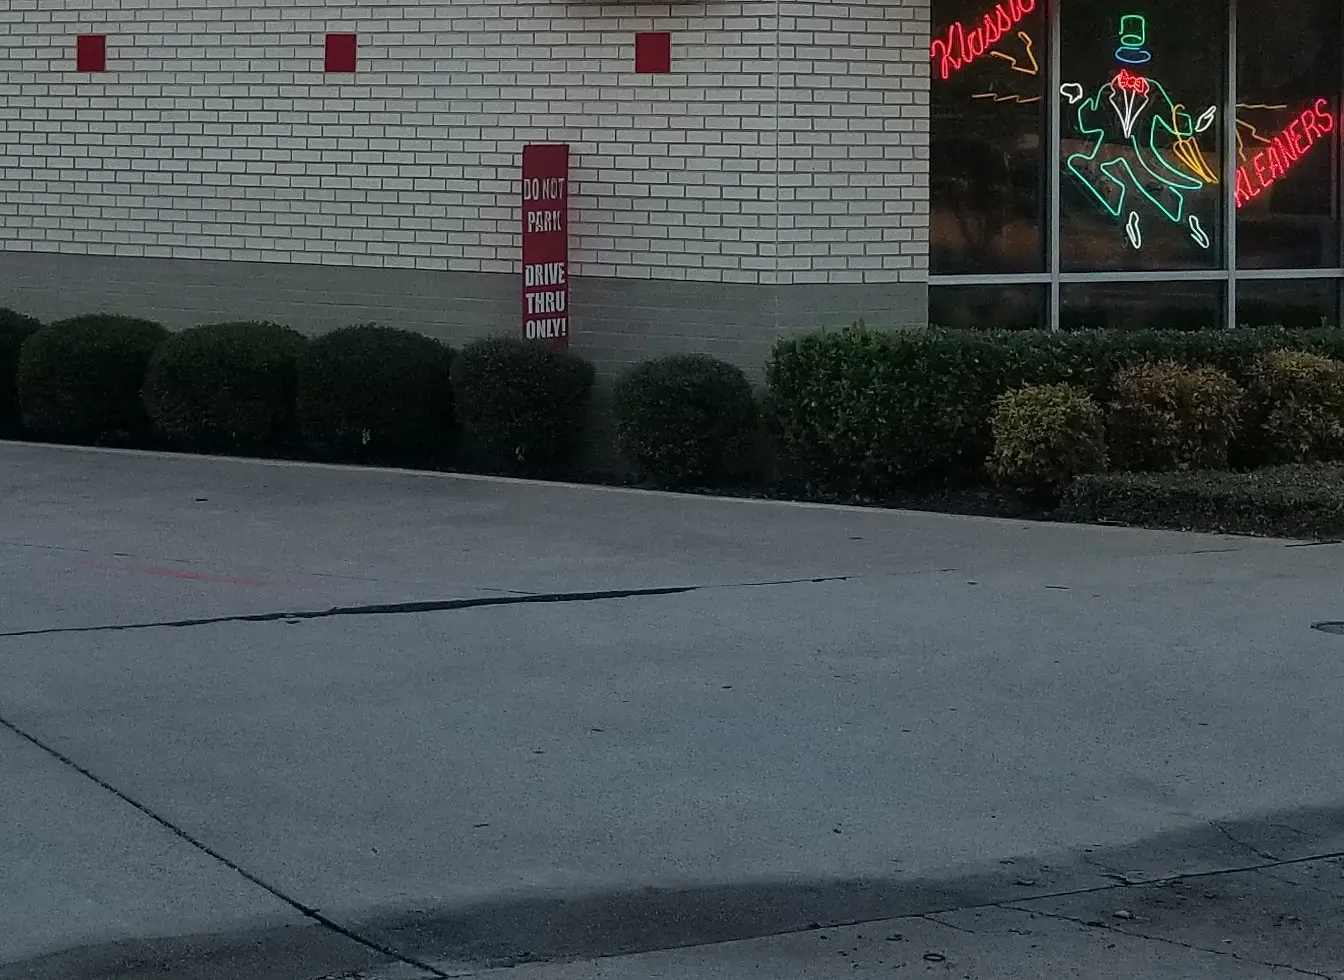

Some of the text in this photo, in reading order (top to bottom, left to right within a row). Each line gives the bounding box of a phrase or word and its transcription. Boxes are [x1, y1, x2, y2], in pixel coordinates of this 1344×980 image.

[1233, 98, 1335, 209] KLEANERS
[524, 177, 565, 201] DO NOT
[525, 262, 565, 287] DRIVE
[525, 290, 565, 314] THRU
[526, 317, 566, 340] ONLY!
